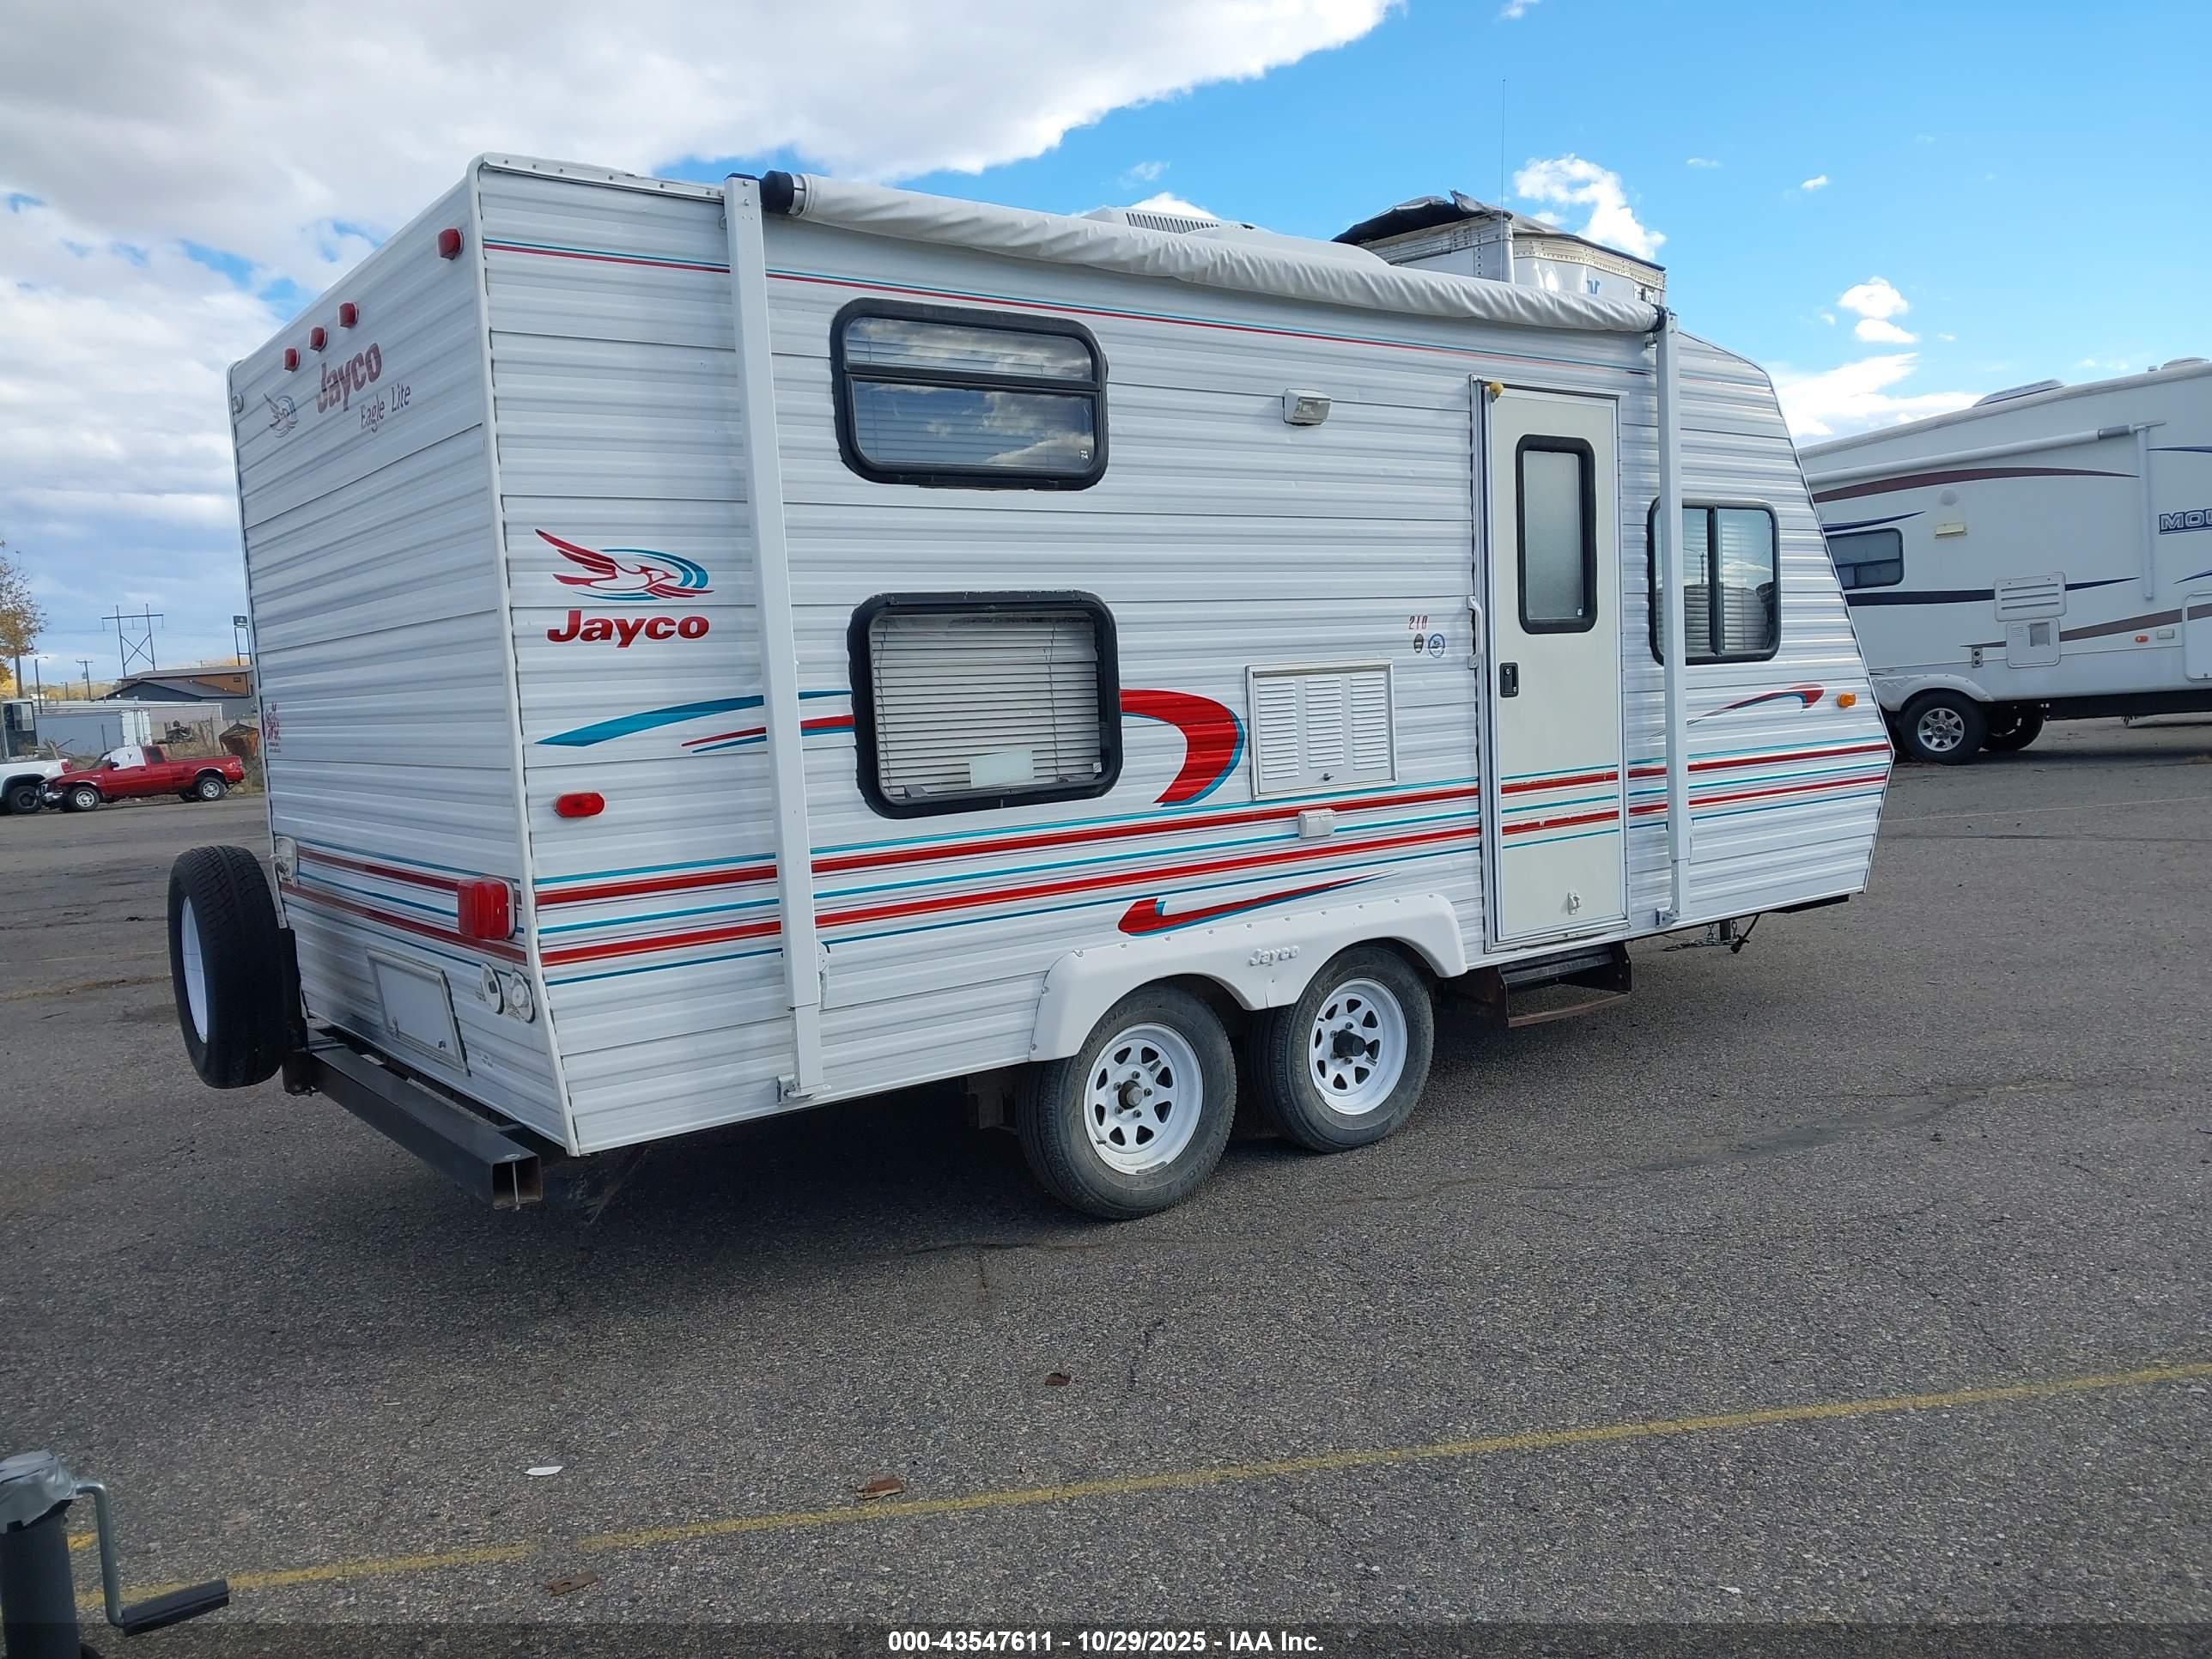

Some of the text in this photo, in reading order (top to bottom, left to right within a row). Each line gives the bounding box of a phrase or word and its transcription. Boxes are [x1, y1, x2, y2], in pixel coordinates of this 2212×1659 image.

[316, 343, 382, 414] Jayco
[360, 383, 411, 433] Eagle Lite
[2159, 508, 2212, 533] MO
[546, 609, 710, 648] Jayco
[1408, 615, 1428, 629] 210
[1249, 945, 1300, 966] Jayco
